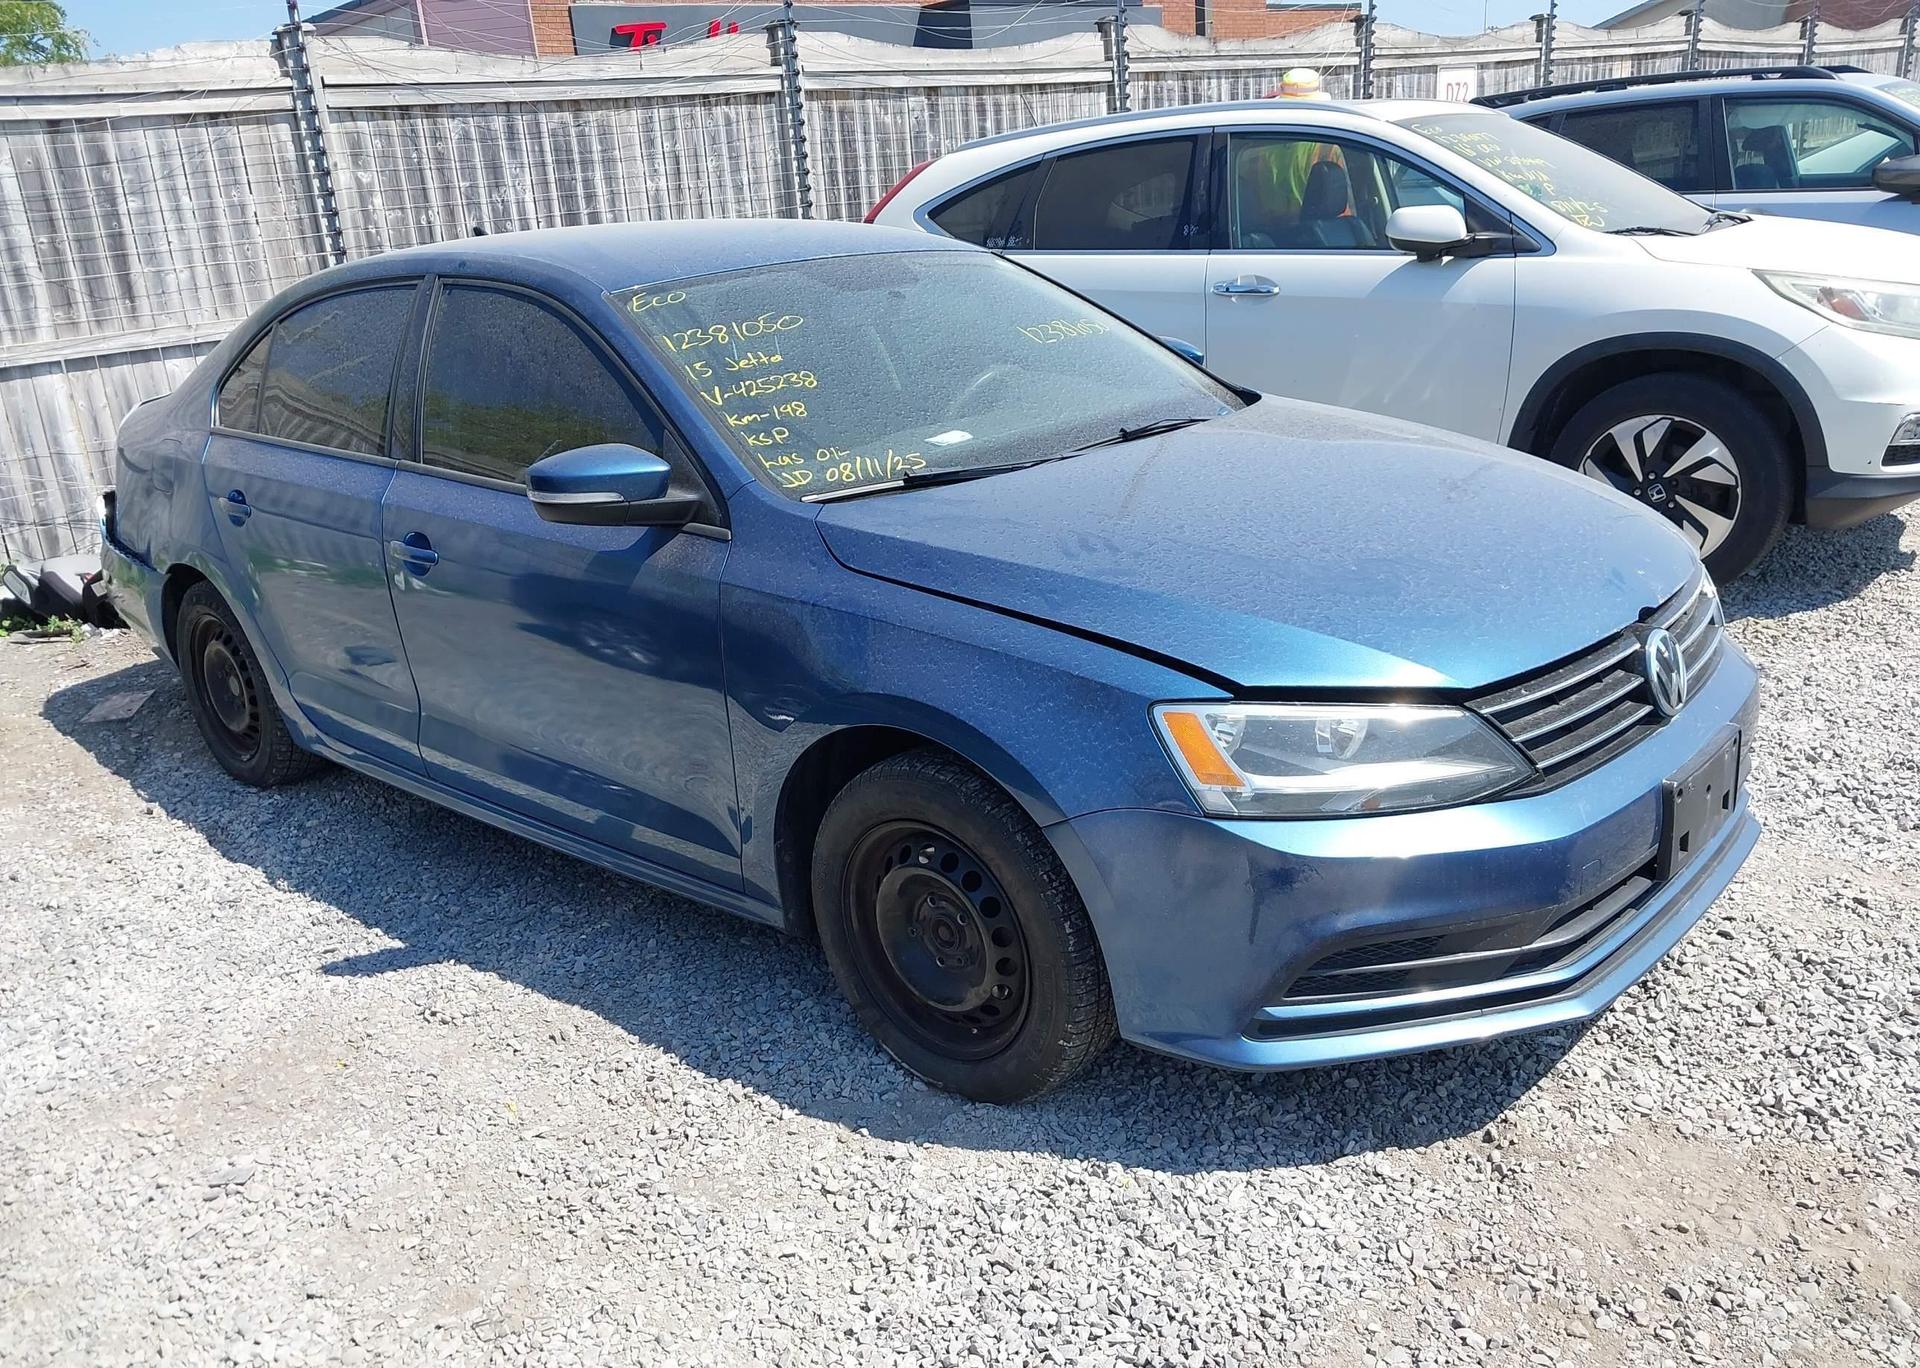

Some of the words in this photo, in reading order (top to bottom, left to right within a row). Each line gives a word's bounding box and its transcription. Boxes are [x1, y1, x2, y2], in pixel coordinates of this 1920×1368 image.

[662, 312, 804, 352] 12381050
[724, 351, 784, 371] Jetta
[825, 449, 927, 481] 08/11/25
